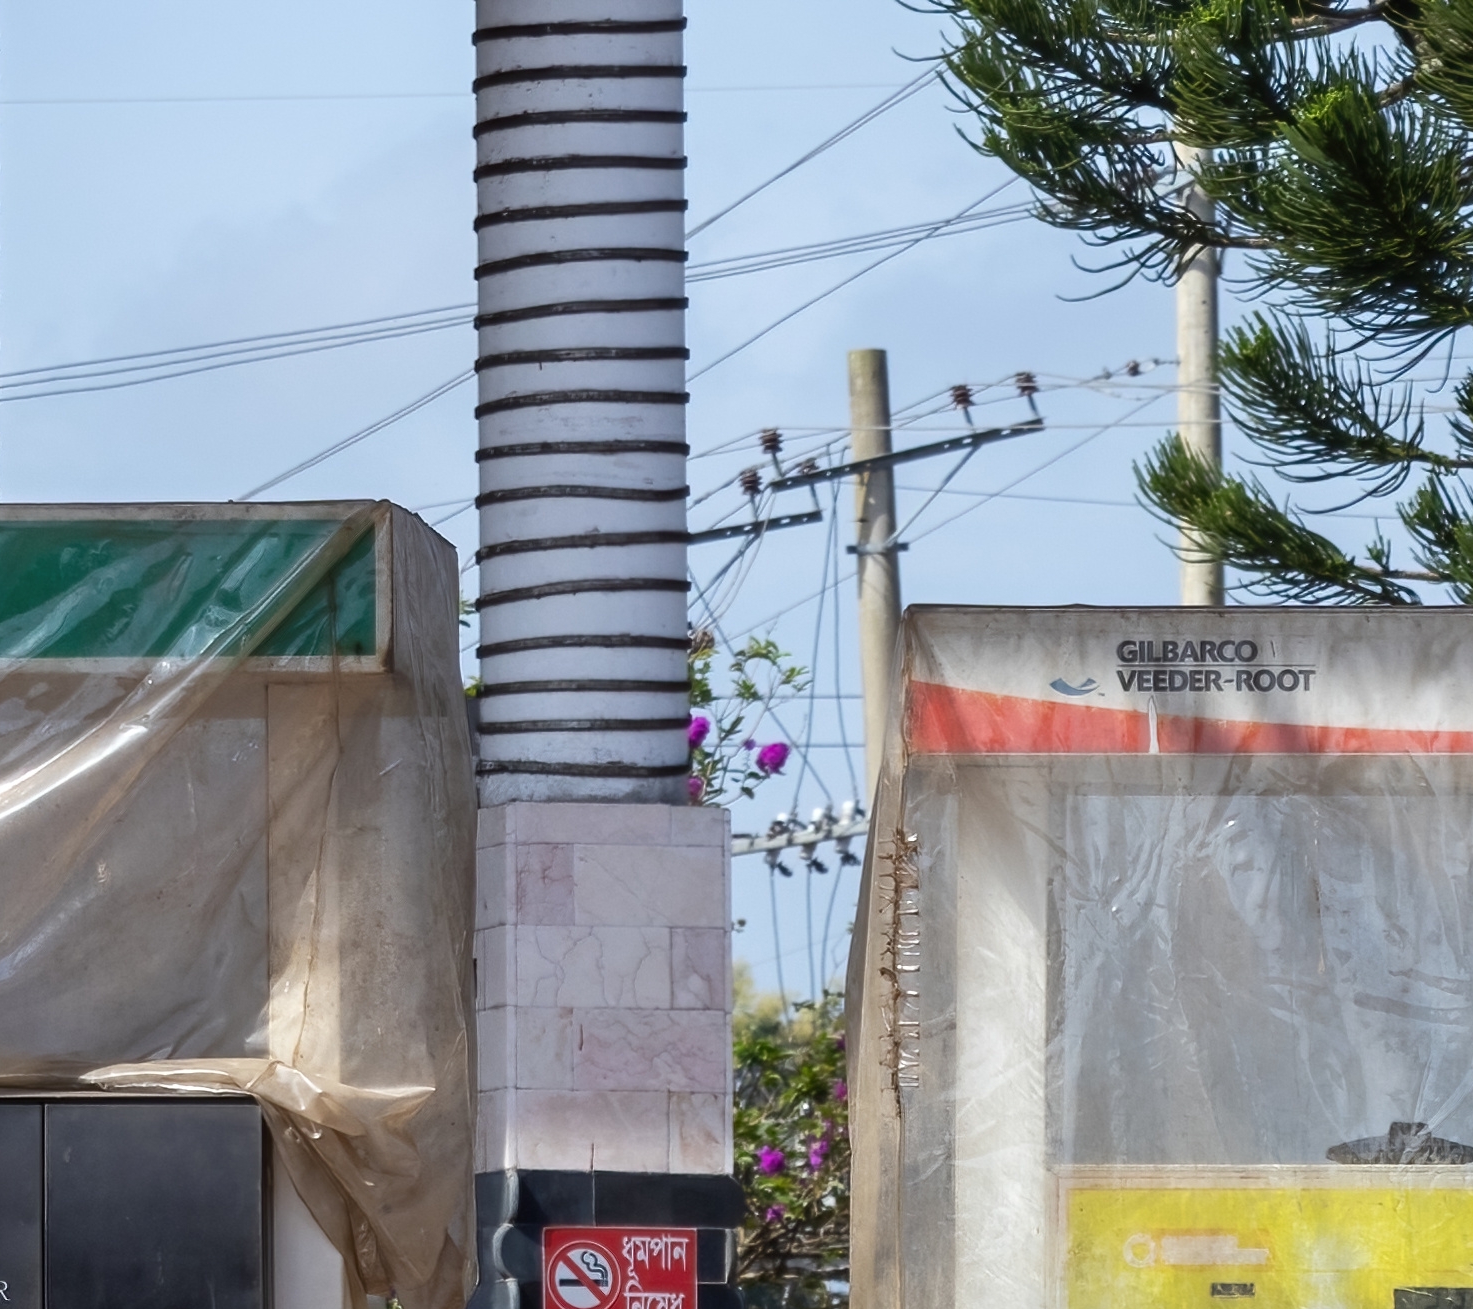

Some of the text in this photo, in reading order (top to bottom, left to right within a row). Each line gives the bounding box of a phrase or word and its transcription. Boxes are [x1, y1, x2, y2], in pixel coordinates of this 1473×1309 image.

[1116, 640, 1258, 663] GILBARCO
[1116, 669, 1317, 692] VEEDER-ROOT
[622, 1234, 689, 1281] ধূমপান
